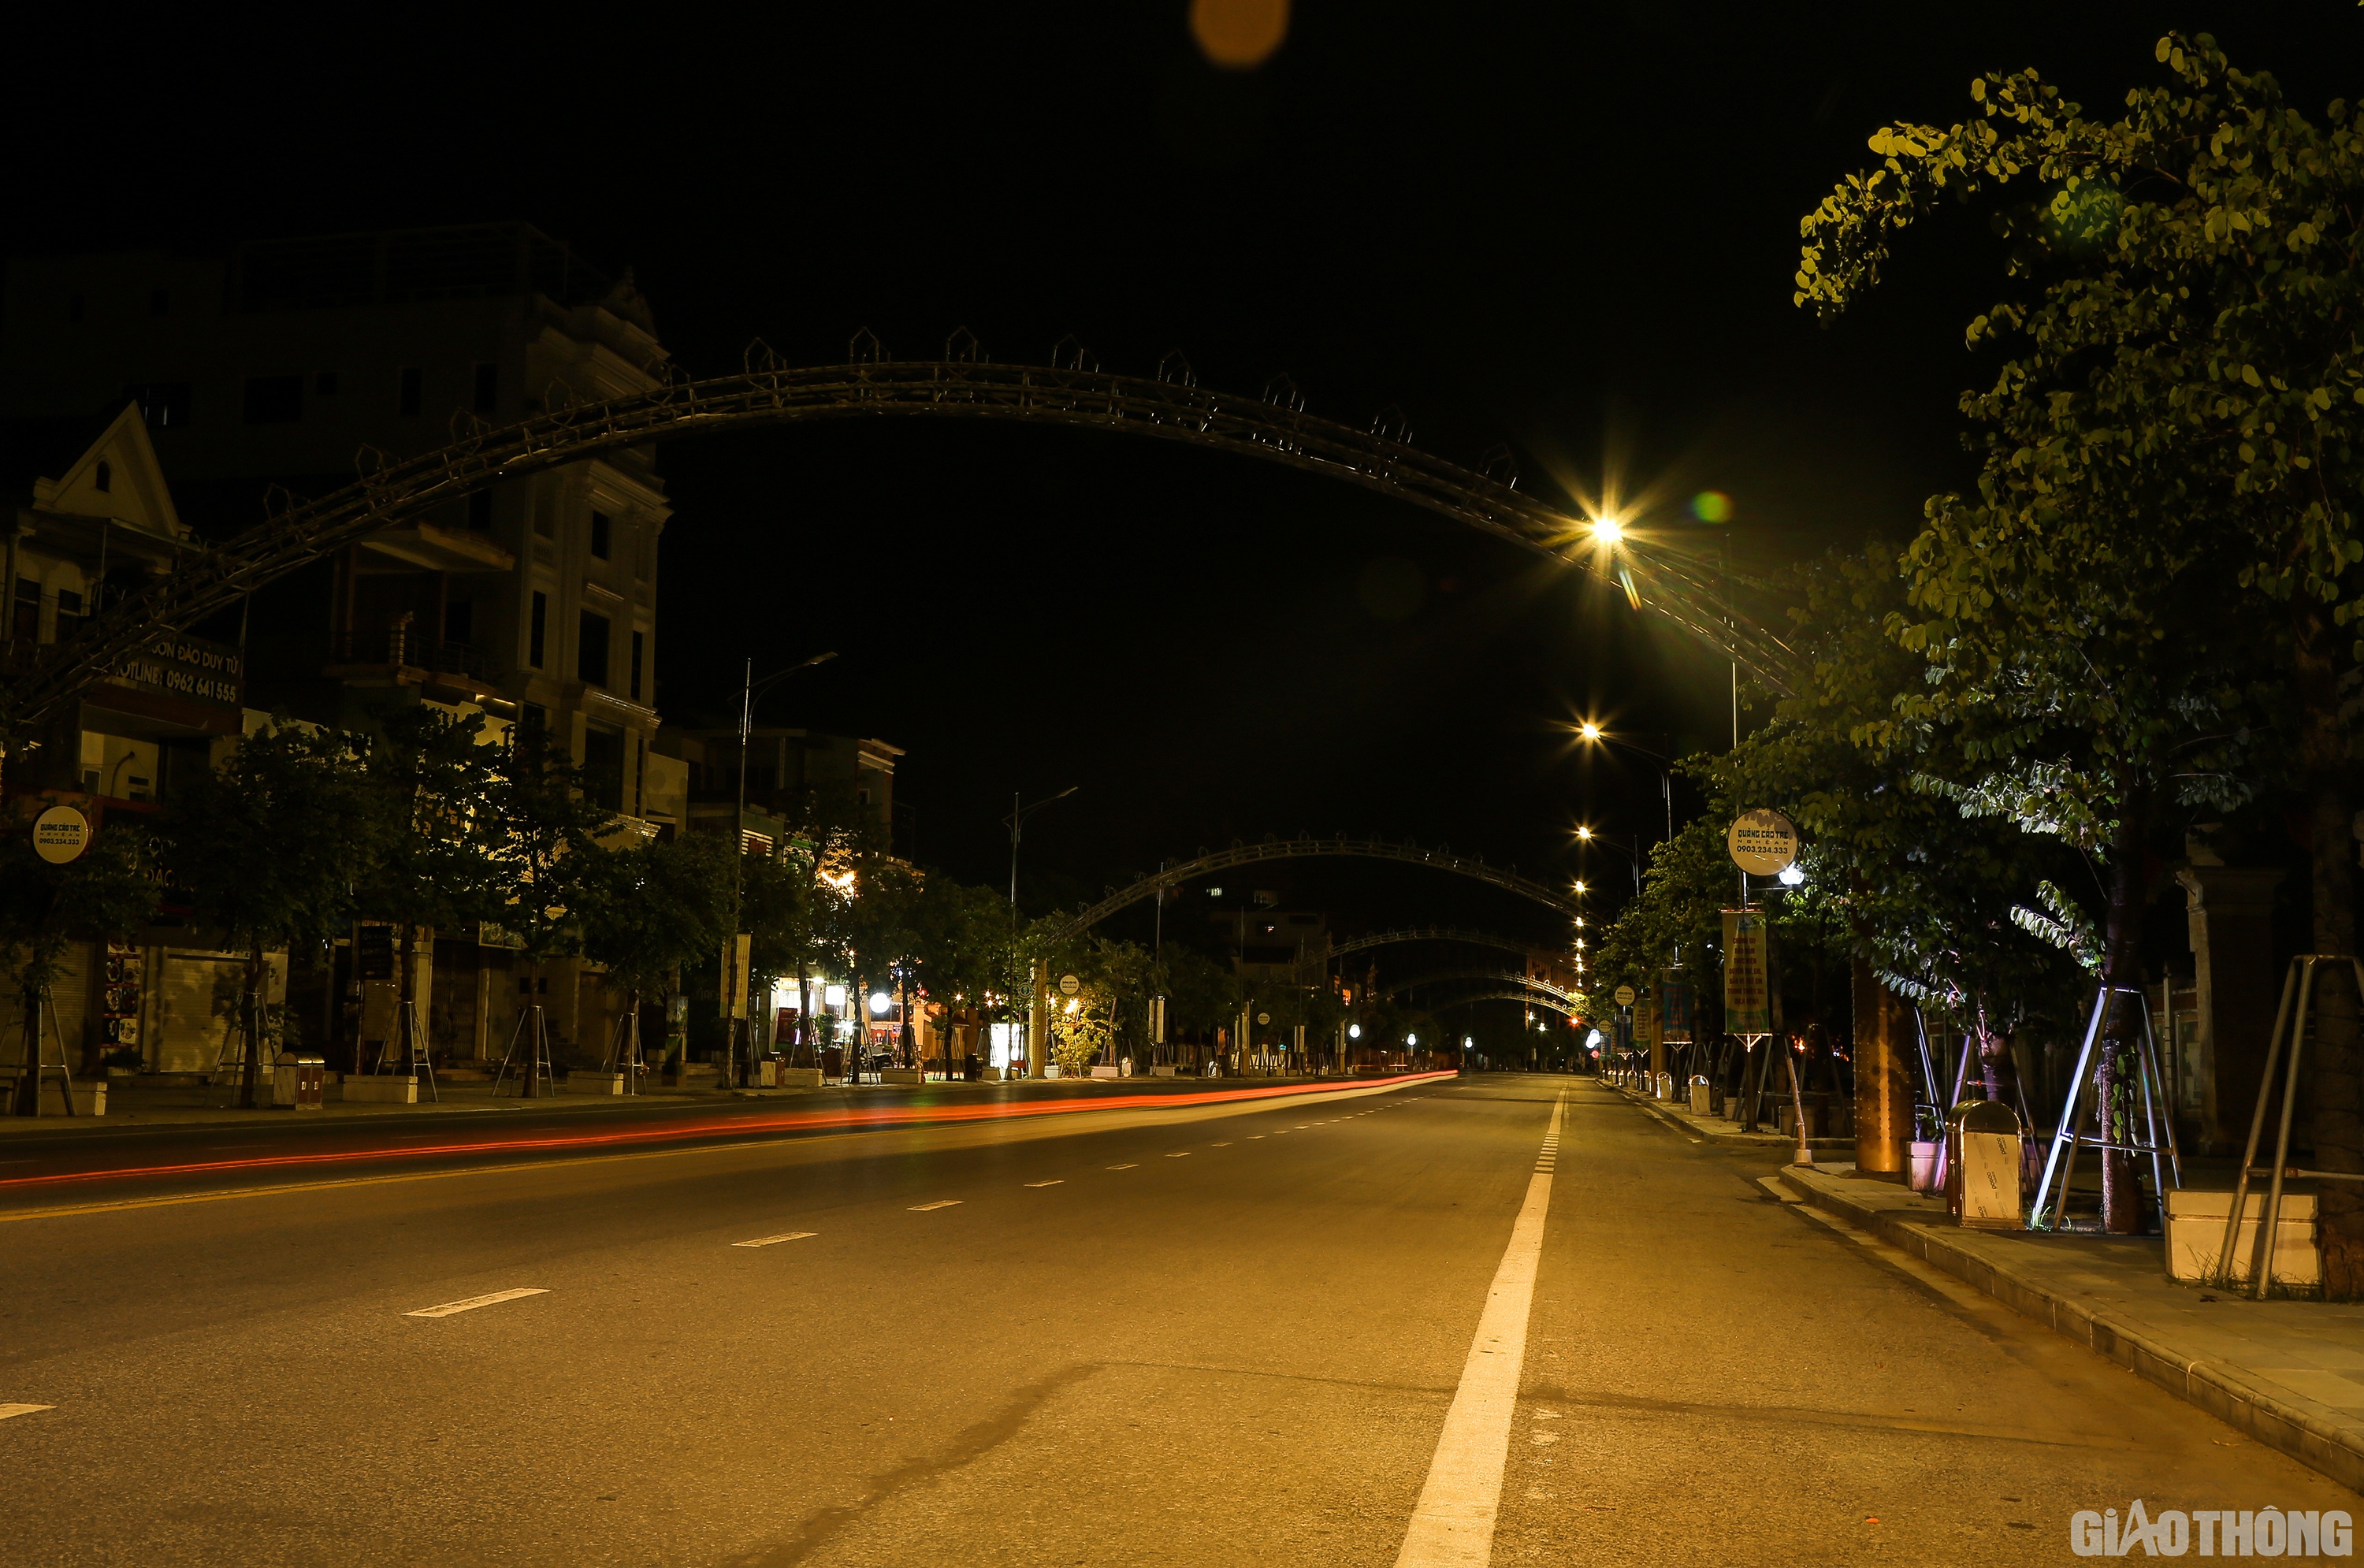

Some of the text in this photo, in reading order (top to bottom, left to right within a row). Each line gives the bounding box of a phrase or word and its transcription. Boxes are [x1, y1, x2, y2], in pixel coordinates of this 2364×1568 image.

[203, 652, 224, 671] DUY
[117, 661, 162, 686] OTLINE:
[166, 670, 195, 693] 0962
[1737, 845, 1788, 854] 0903.234.333
